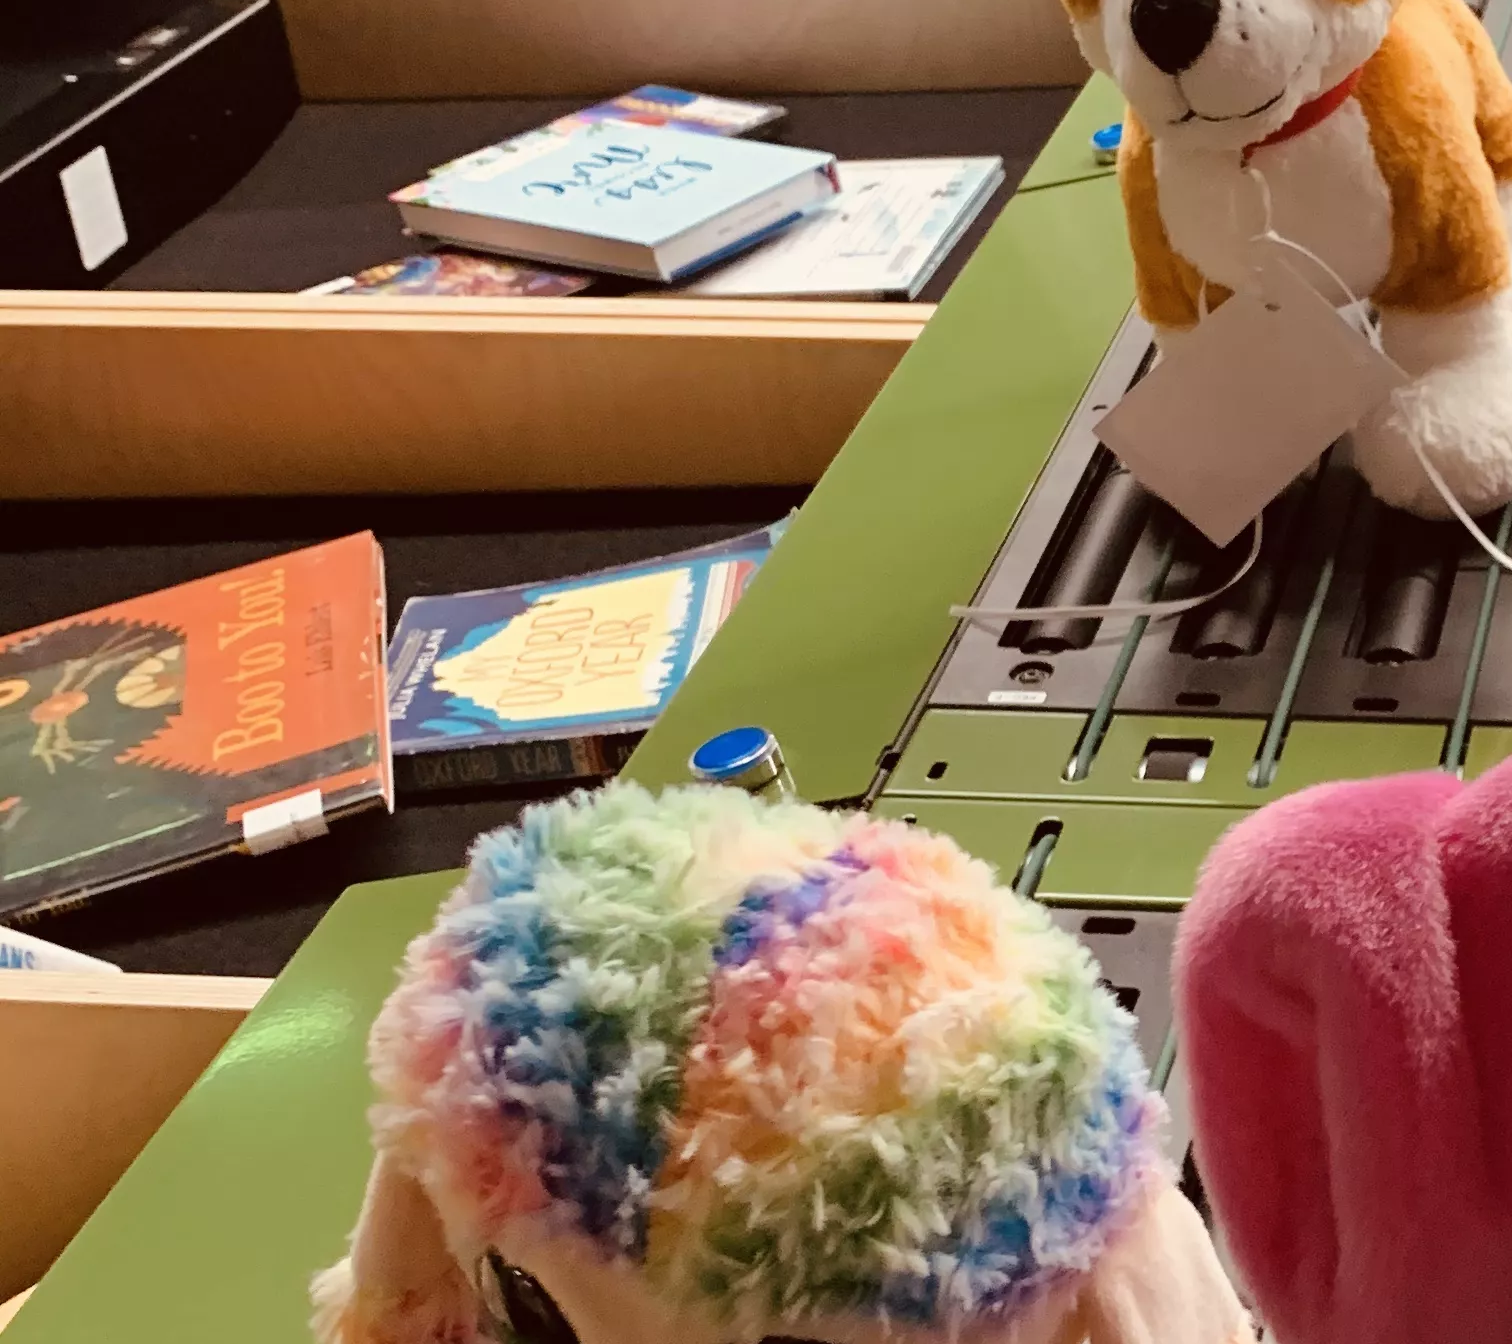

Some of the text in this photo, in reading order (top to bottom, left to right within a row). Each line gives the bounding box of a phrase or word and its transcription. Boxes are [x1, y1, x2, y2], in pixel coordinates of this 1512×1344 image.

[212, 567, 287, 763] Boo to You!
[496, 607, 594, 709] OXFORD
[573, 613, 653, 687] YEAR
[510, 744, 563, 775] YEAR
